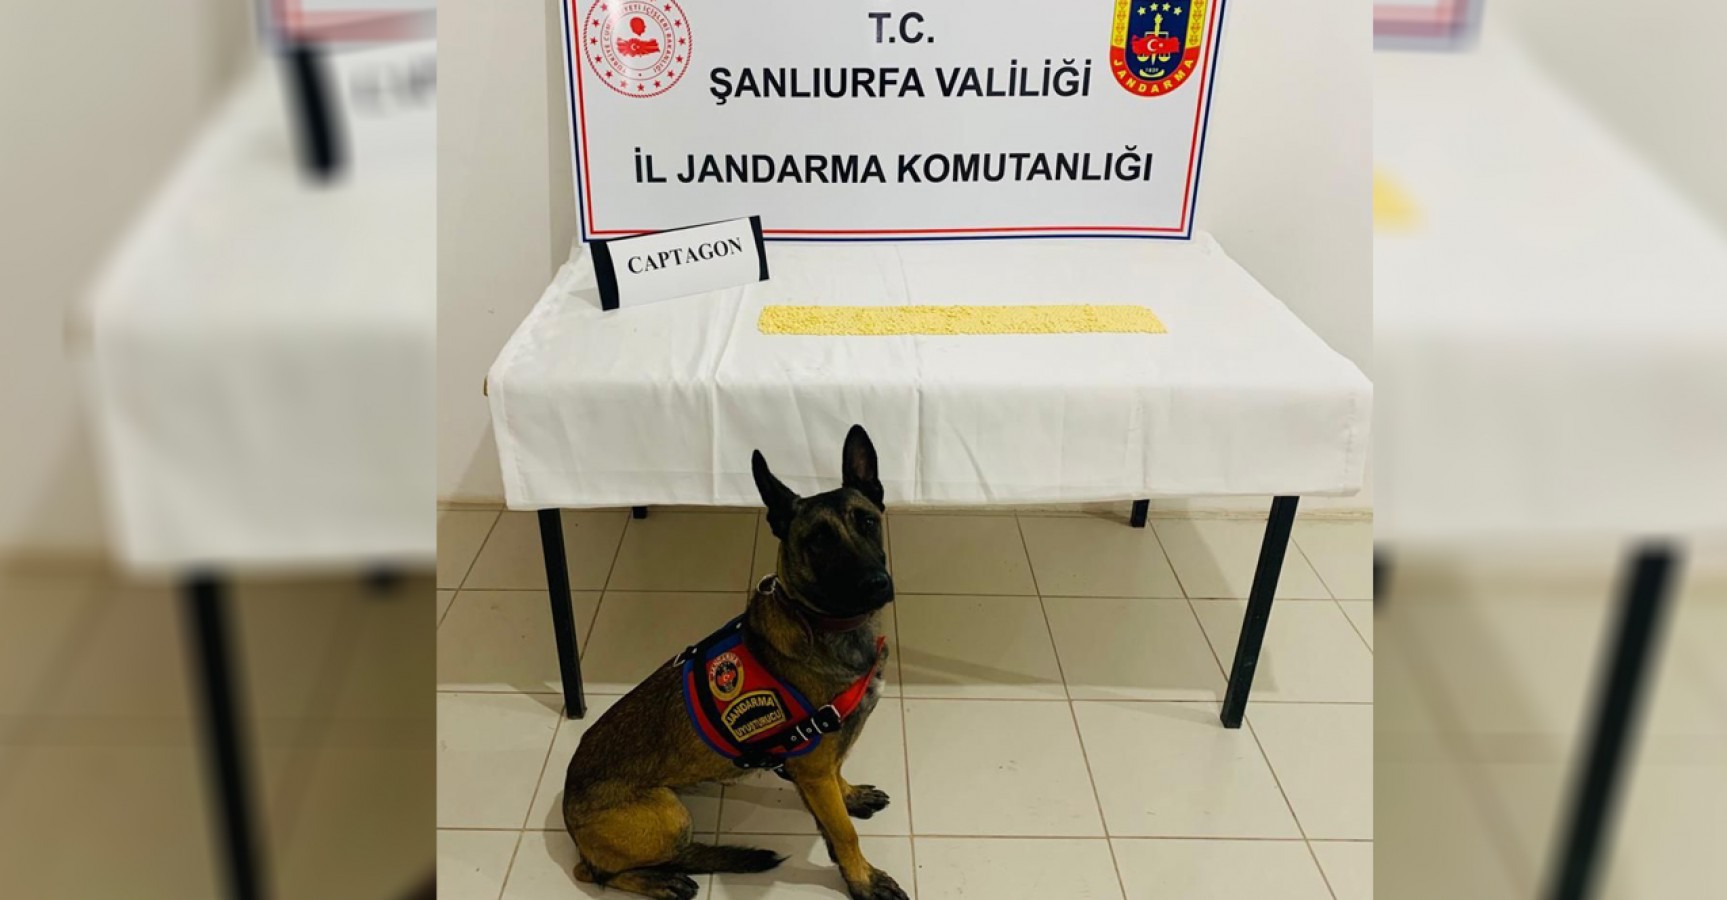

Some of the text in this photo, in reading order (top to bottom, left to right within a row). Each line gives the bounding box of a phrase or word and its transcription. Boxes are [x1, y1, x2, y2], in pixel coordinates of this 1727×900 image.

[868, 11, 935, 44] T.C.
[710, 58, 1092, 106] ŞANLIURFA VALİLİĞİ
[1113, 59, 1194, 93] JANDARMA
[634, 144, 1153, 184] İL JANDARMA KOMUTANLIĞI
[627, 236, 744, 274] CAPTAGON
[726, 696, 775, 725] JANDARMA
